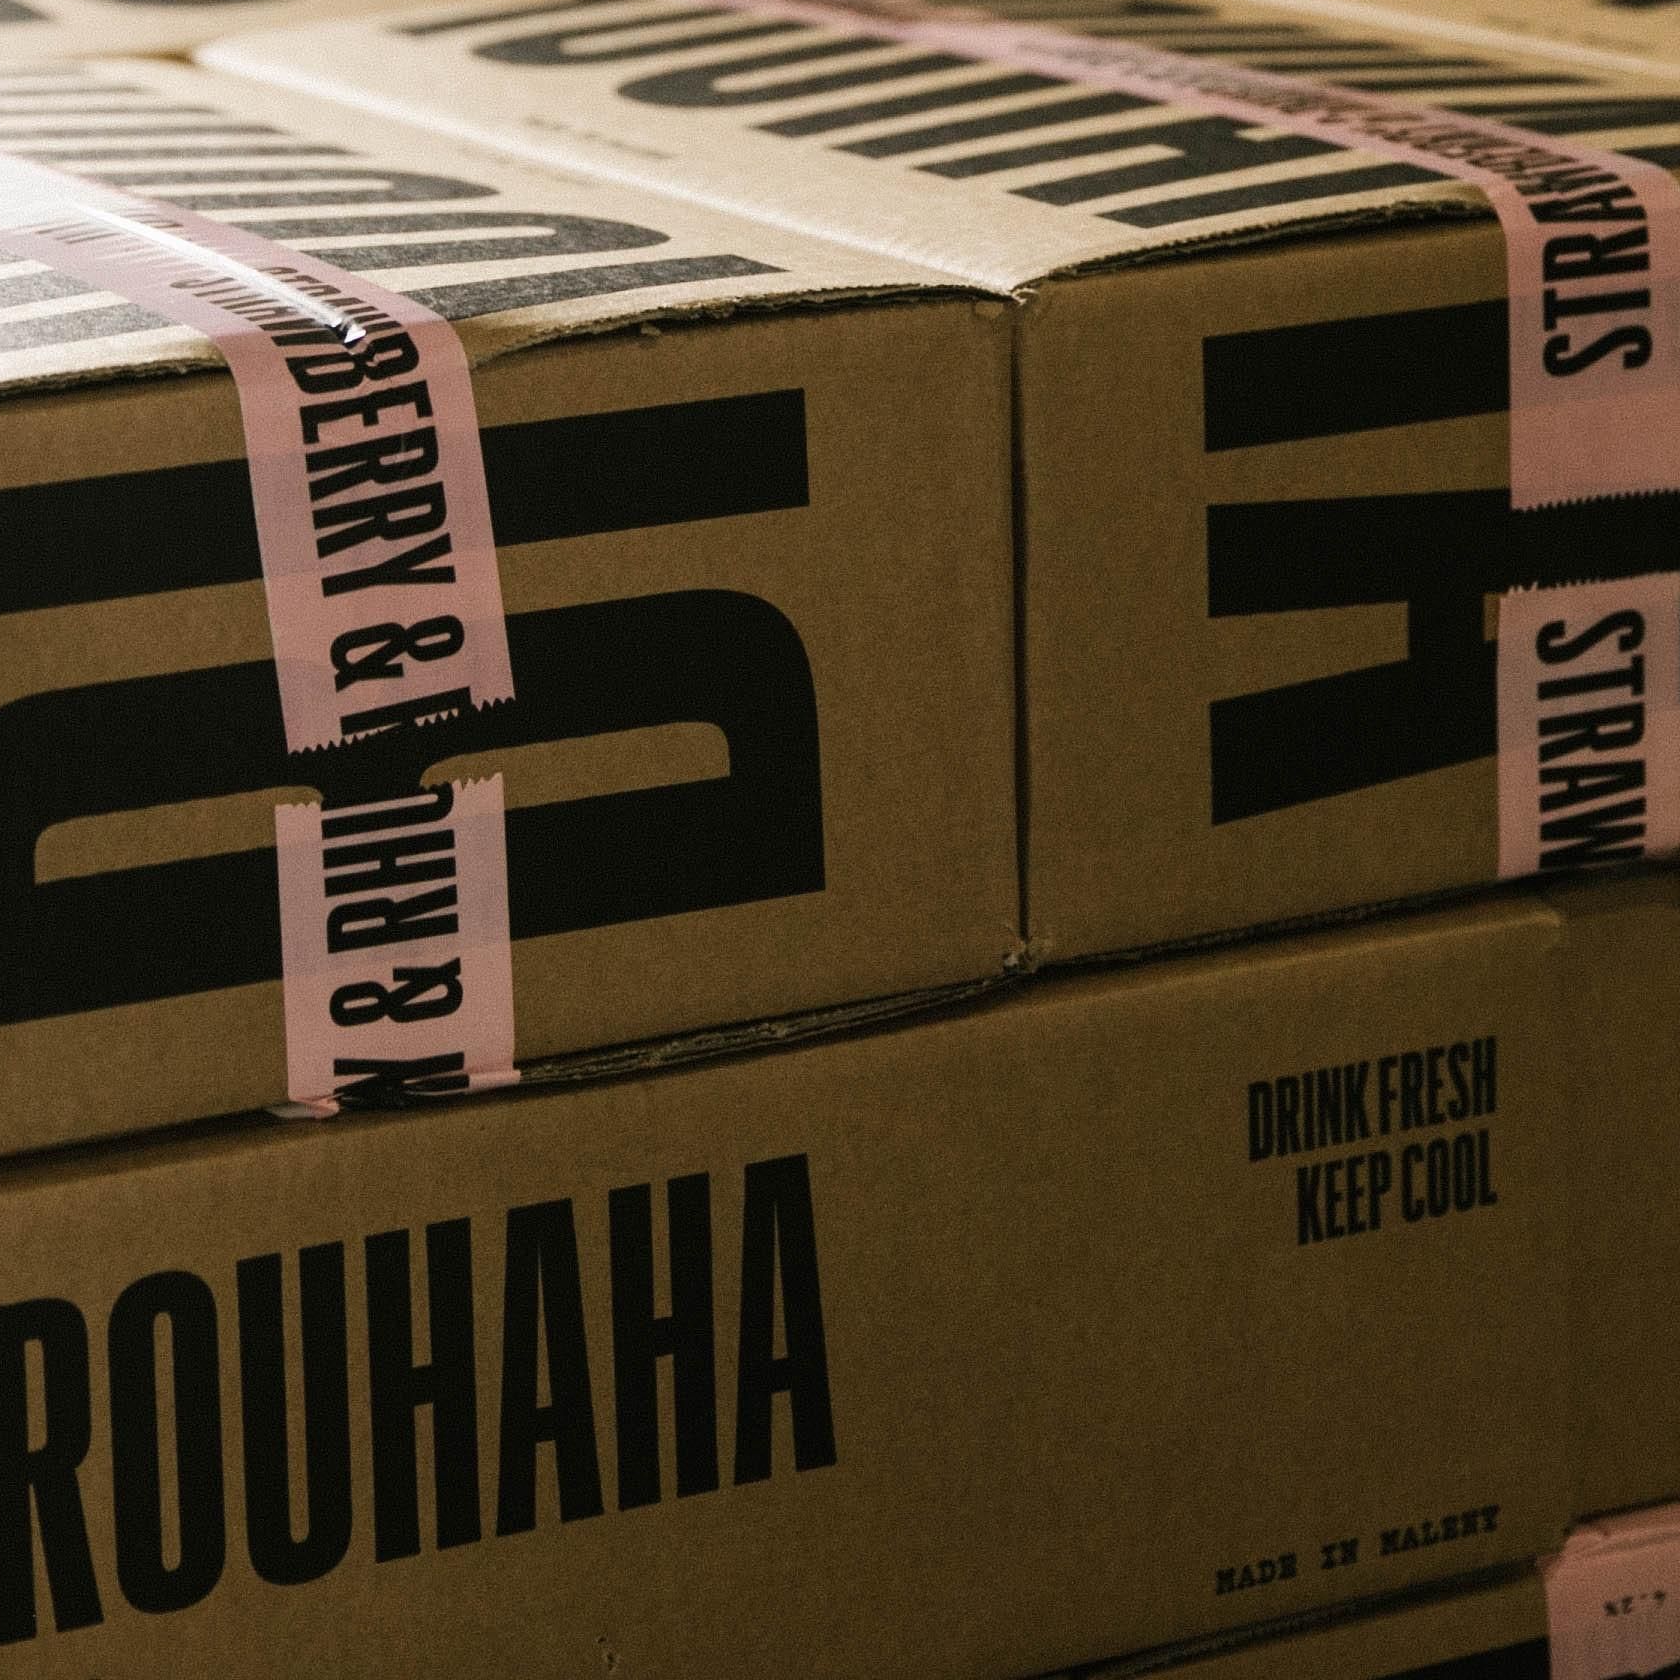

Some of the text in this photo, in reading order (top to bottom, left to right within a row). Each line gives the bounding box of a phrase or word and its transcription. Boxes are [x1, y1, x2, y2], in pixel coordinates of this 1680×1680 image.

[327, 613, 467, 692] &
[328, 956, 464, 1027] &
[1247, 1035, 1498, 1163] DRINK FRESH
[1296, 1128, 1499, 1246] KEEP COOL
[1214, 1501, 1502, 1596] MADE IN MALENY
